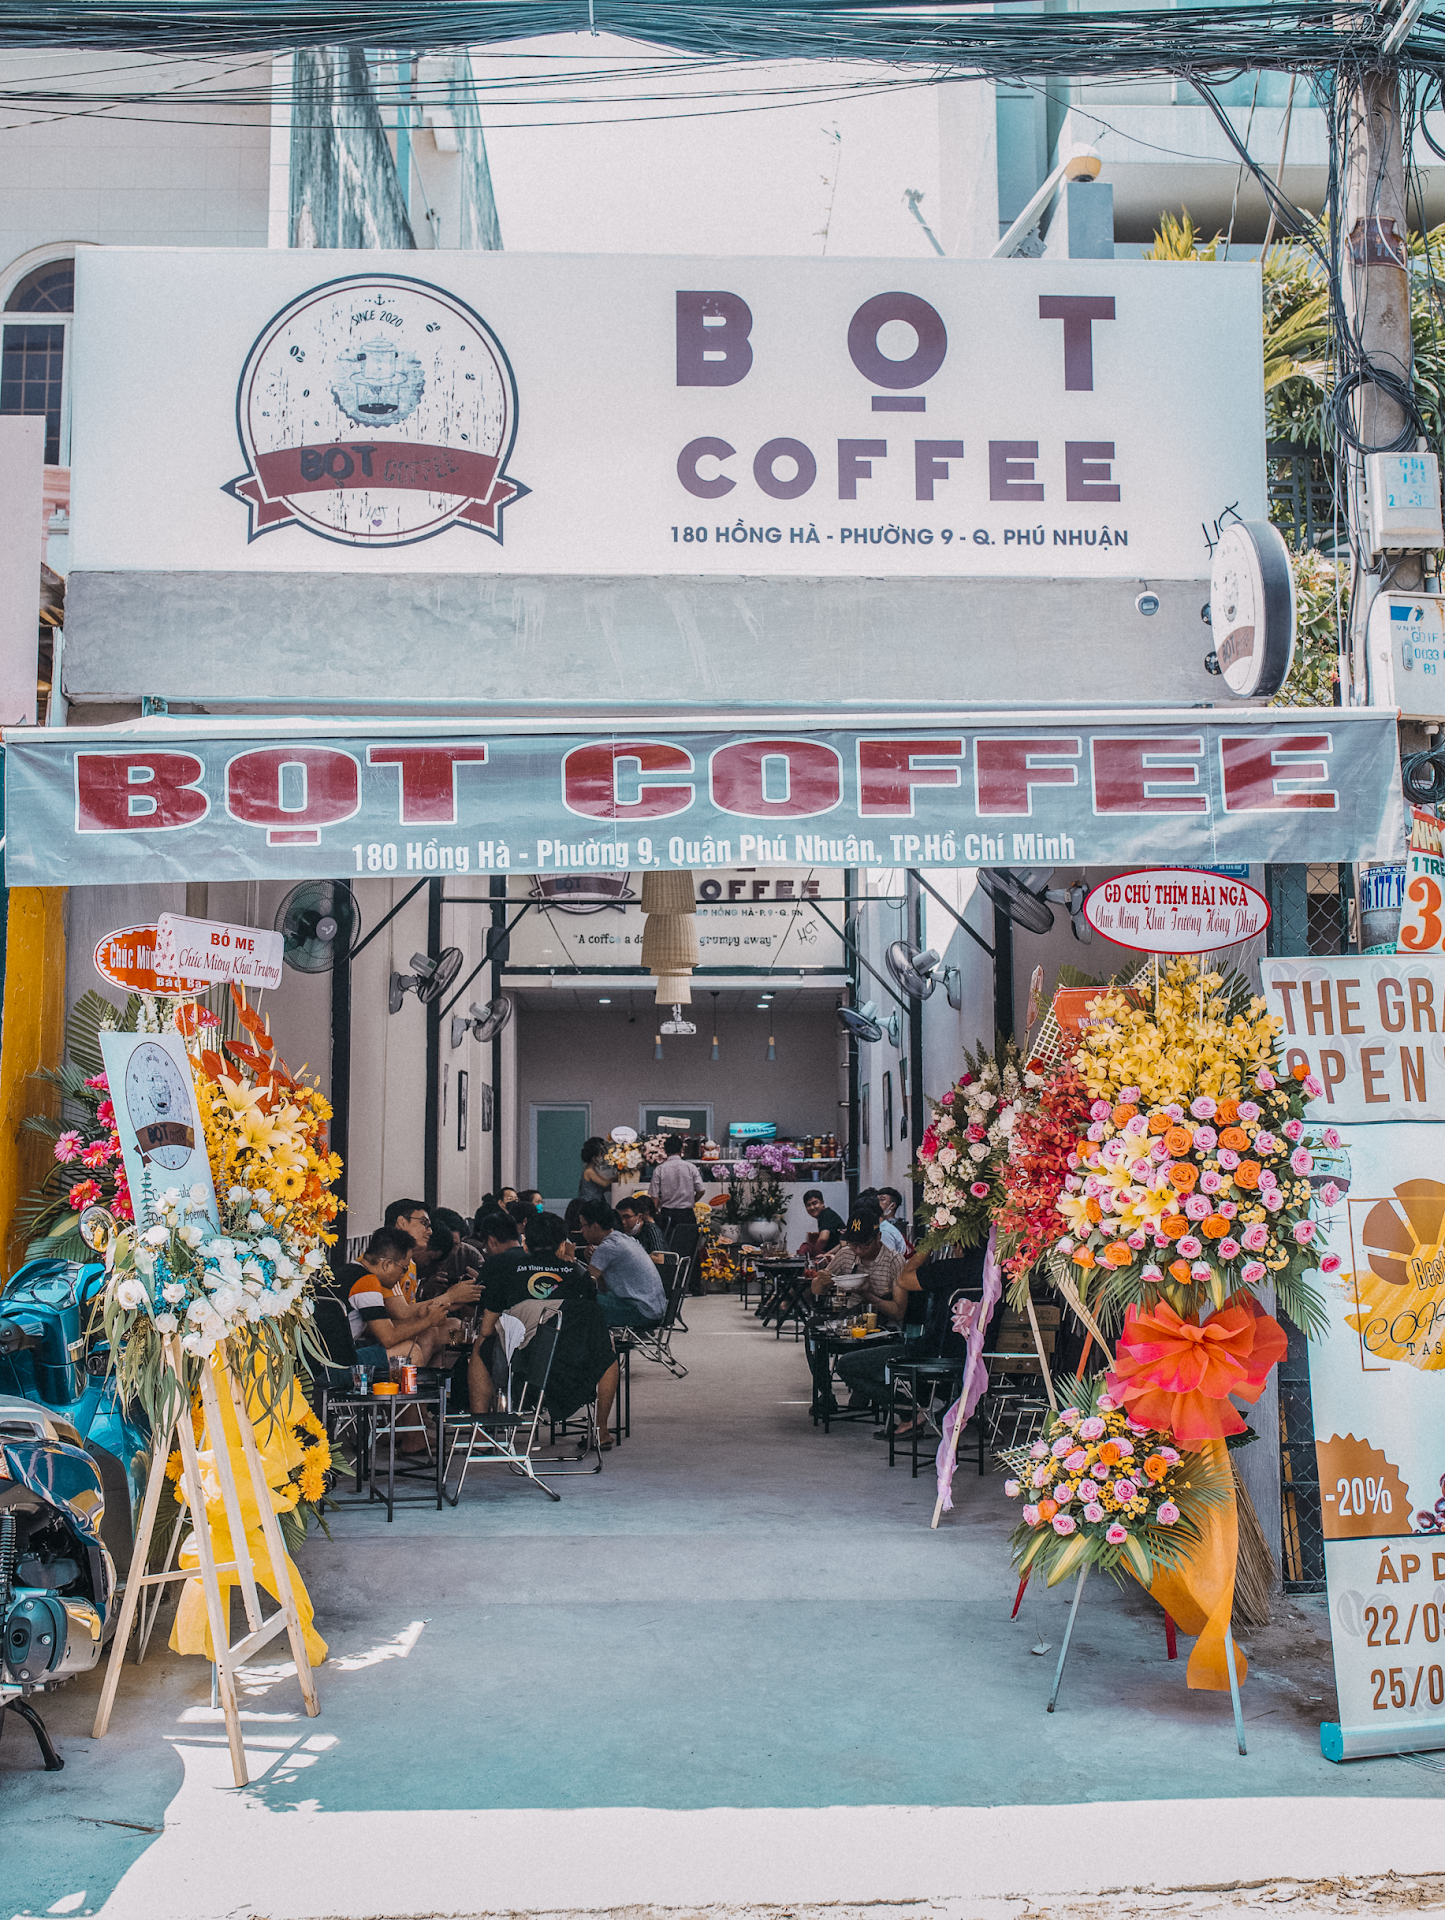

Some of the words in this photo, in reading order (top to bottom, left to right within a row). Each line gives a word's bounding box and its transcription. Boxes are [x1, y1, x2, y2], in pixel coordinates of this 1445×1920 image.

[351, 309, 375, 326] SINCE
[380, 310, 403, 327] 2020
[383, 452, 460, 484] COFFEE
[677, 436, 1121, 502] COFFEE
[671, 526, 708, 543] 180
[715, 518, 782, 544] HỒNG
[790, 522, 820, 544] HÀ
[840, 522, 934, 545] PHƯỜNG
[941, 528, 953, 545] 9
[972, 528, 996, 546] Q.
[1003, 524, 1045, 546] PHÚ
[1053, 525, 1128, 551] NHUẬN
[561, 731, 1340, 821] COFFEE
[352, 843, 398, 871] 180
[406, 838, 470, 873] Hồng
[478, 839, 511, 869] Hà
[537, 836, 630, 869] Phường
[637, 836, 660, 868] 9,
[669, 835, 731, 868] Quận
[740, 834, 787, 862] Phú
[795, 834, 883, 868] Nhuận,
[964, 833, 1005, 861] Chí
[1012, 833, 1075, 860] Minh
[1411, 856, 1419, 872] 1
[700, 879, 821, 900] OFFEE
[1104, 884, 1122, 903] GĐ
[1124, 880, 1151, 904] CHÚ
[1154, 880, 1188, 905] THÍM
[1219, 886, 1249, 906] NGA
[711, 905, 738, 916] HỒNG
[1095, 904, 1114, 930] Chúc
[1115, 905, 1139, 935] Mừng
[1143, 906, 1166, 931] Khai
[1206, 908, 1231, 938] Hồng
[1234, 908, 1258, 937] Phát
[1401, 875, 1445, 951] 3
[109, 942, 134, 969] Chúc
[210, 928, 231, 948] BỐ
[235, 937, 255, 955] MẸ
[588, 933, 621, 944] coffee
[624, 936, 631, 944] a
[699, 936, 740, 947] grumpy
[179, 947, 203, 968] Chúc
[203, 952, 231, 980] Mừng
[232, 956, 254, 975] Khai
[156, 976, 182, 988] Bác
[1271, 979, 1365, 1036] THE
[1376, 977, 1445, 1033] GR
[1406, 1341, 1443, 1356] TAS
[1325, 1477, 1393, 1517] -20%
[1376, 1545, 1421, 1585] ÁP
[1364, 1602, 1445, 1647] 22/0
